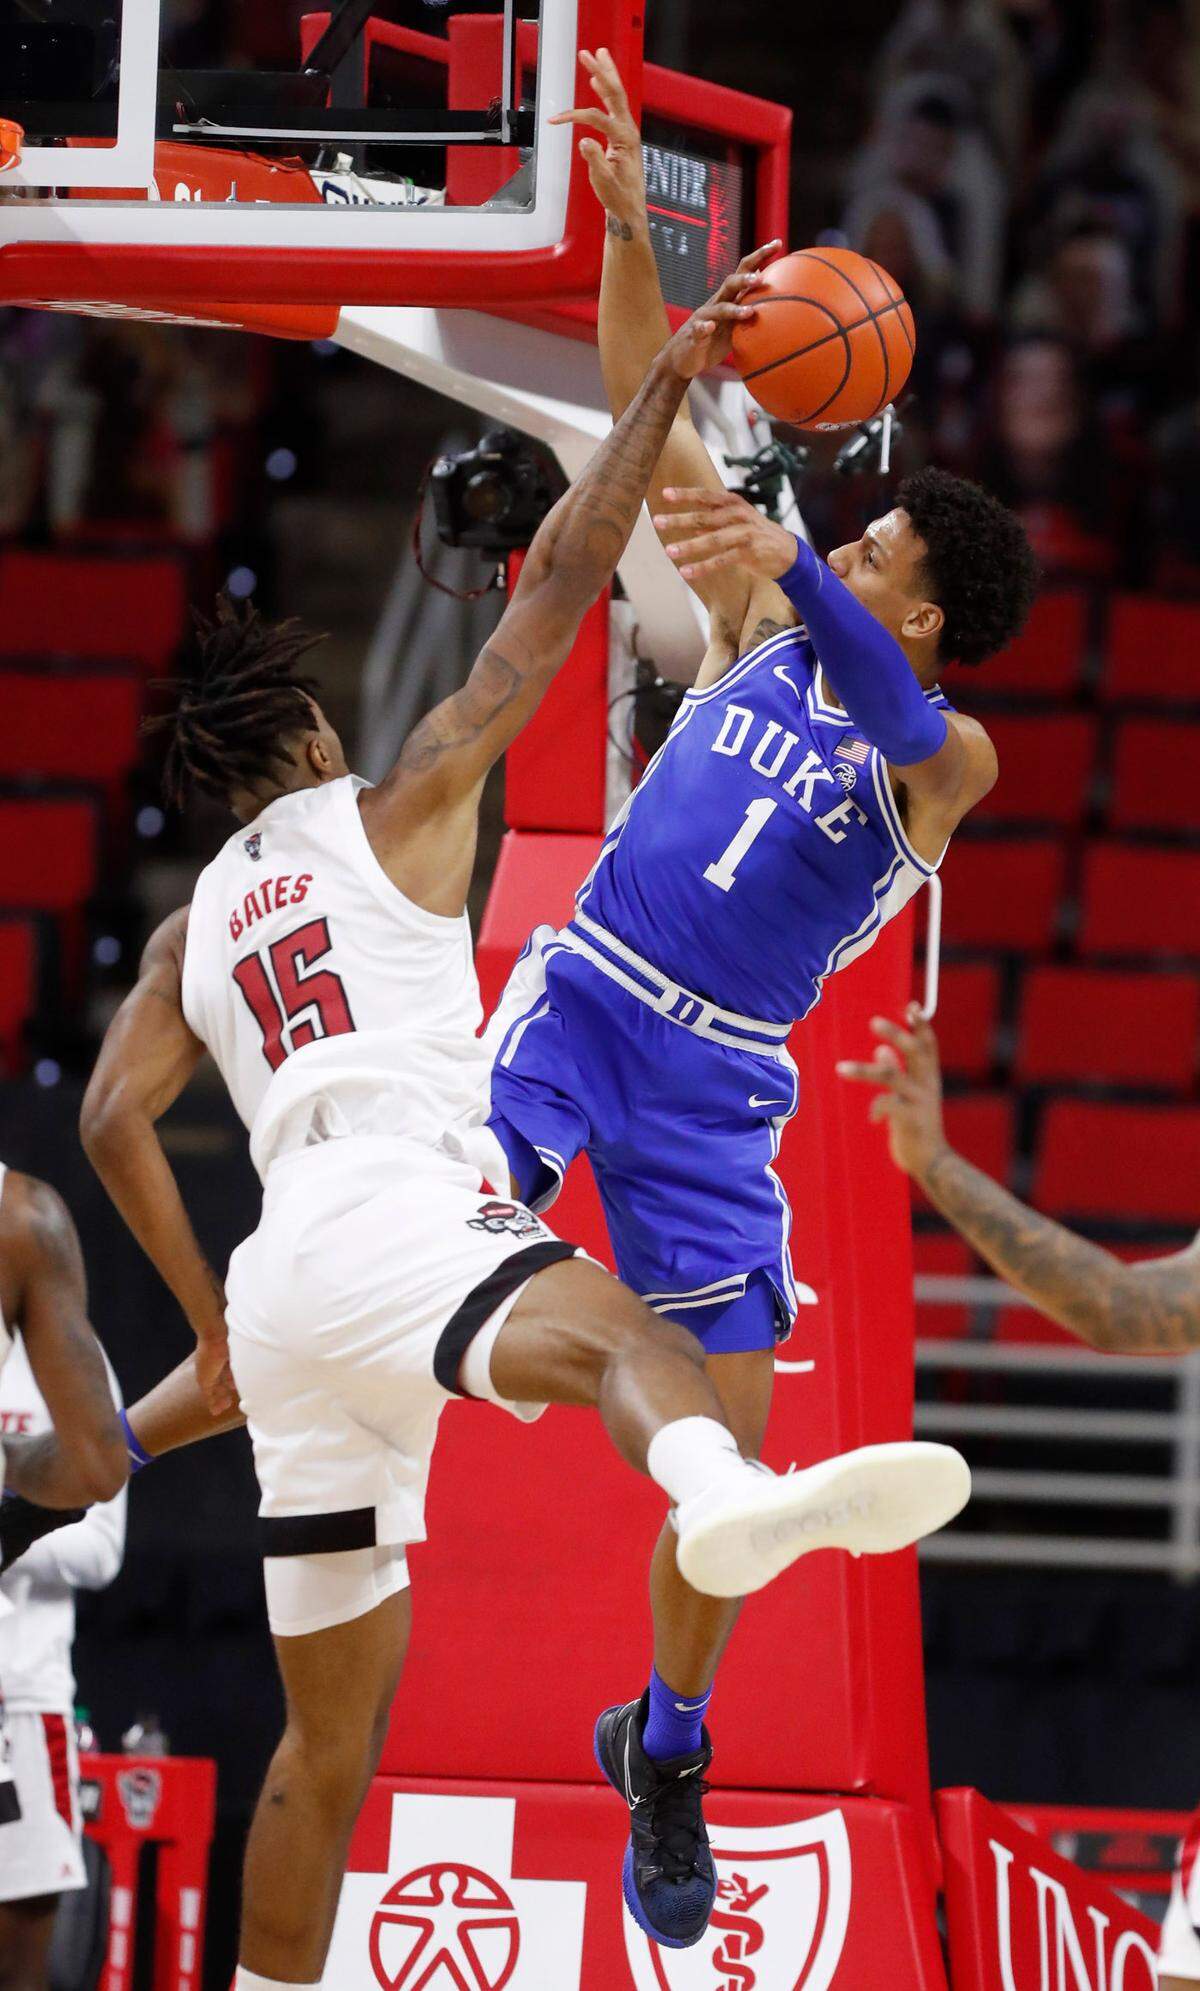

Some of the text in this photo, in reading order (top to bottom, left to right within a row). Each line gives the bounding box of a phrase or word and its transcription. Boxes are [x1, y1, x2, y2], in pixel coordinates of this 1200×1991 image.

[711, 704, 868, 844] DUKE
[703, 797, 778, 892] 1
[228, 873, 313, 942] BATES
[232, 916, 357, 1073] 15
